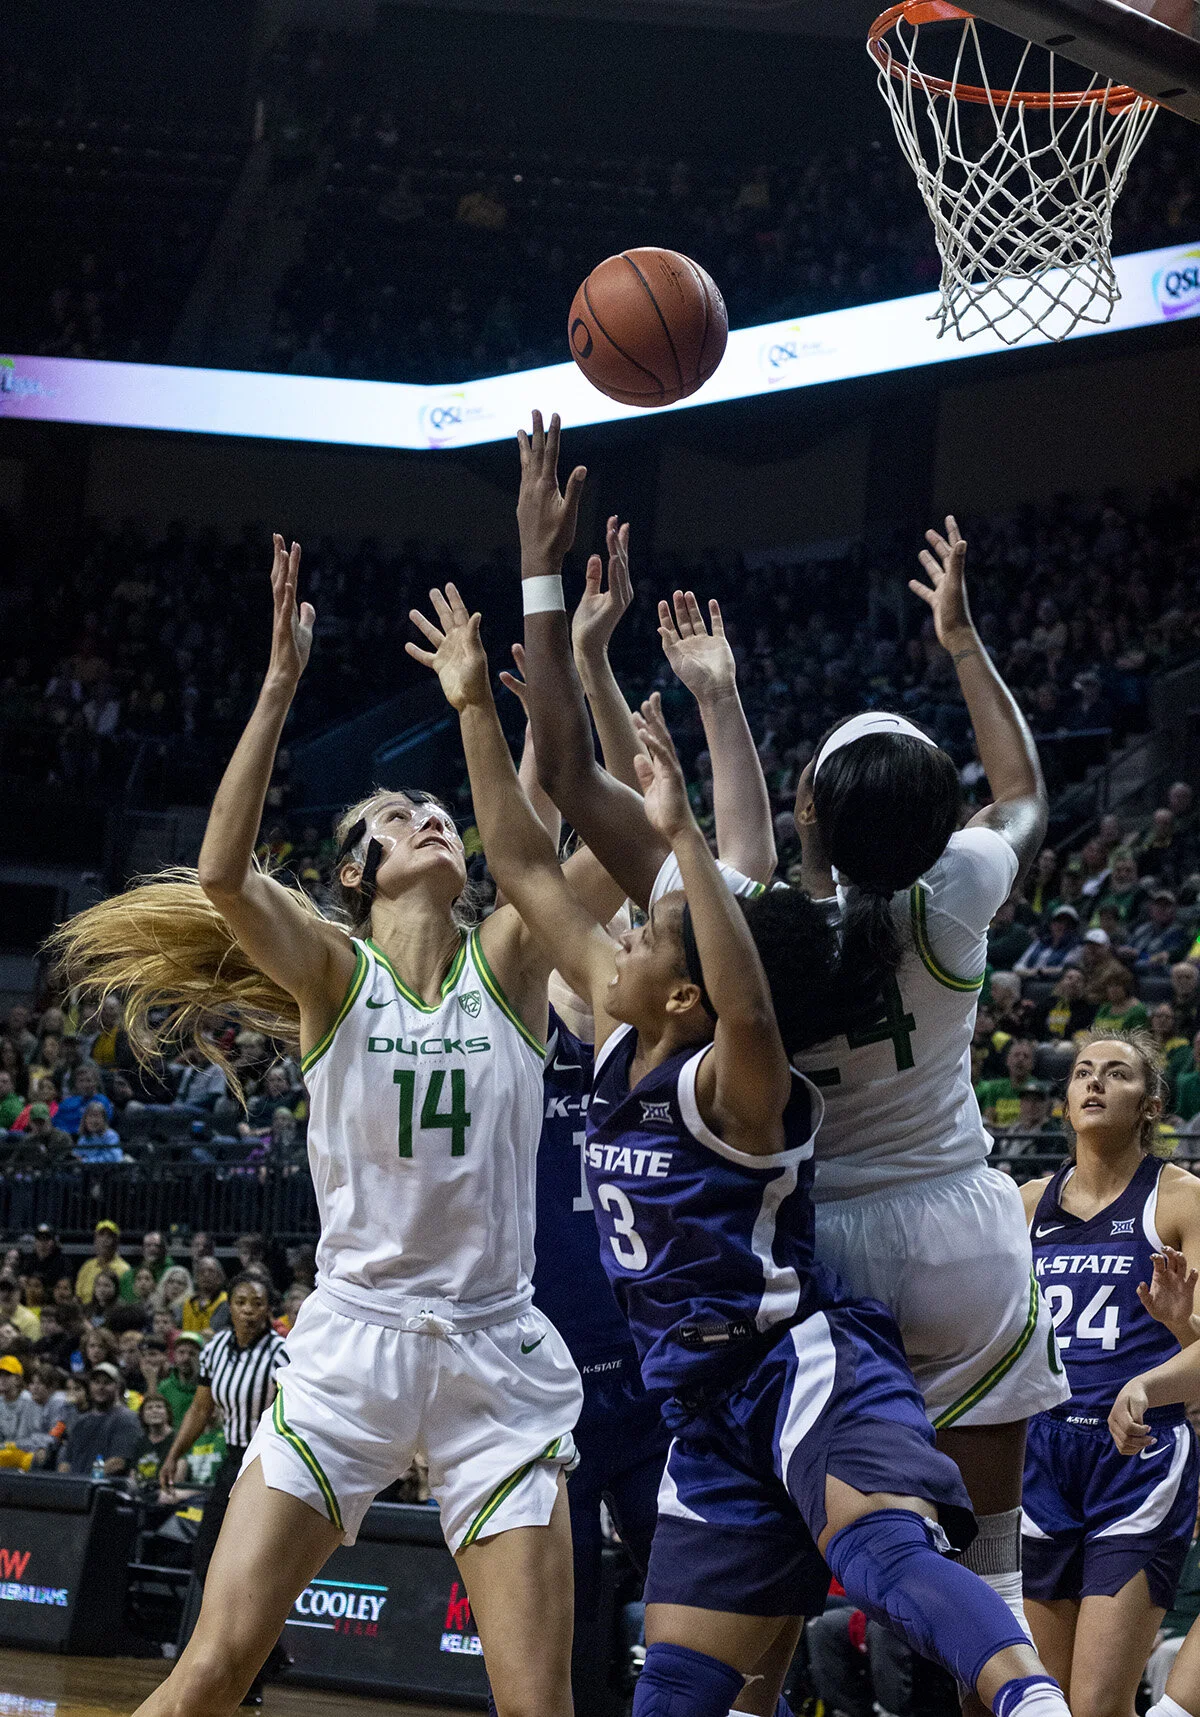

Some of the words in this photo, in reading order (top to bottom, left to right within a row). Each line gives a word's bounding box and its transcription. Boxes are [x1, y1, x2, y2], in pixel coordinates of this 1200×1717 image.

[367, 1036, 491, 1056] DUCKS
[392, 1069, 472, 1158] 14
[583, 1143, 673, 1178] -STATE
[597, 1183, 649, 1272] 3
[1035, 1255, 1134, 1276] K-STATE
[1044, 1284, 1121, 1351] 24
[582, 1358, 623, 1375] K-STATE
[1066, 1415, 1100, 1426] K-STATE
[293, 1587, 387, 1622] COOLEY
